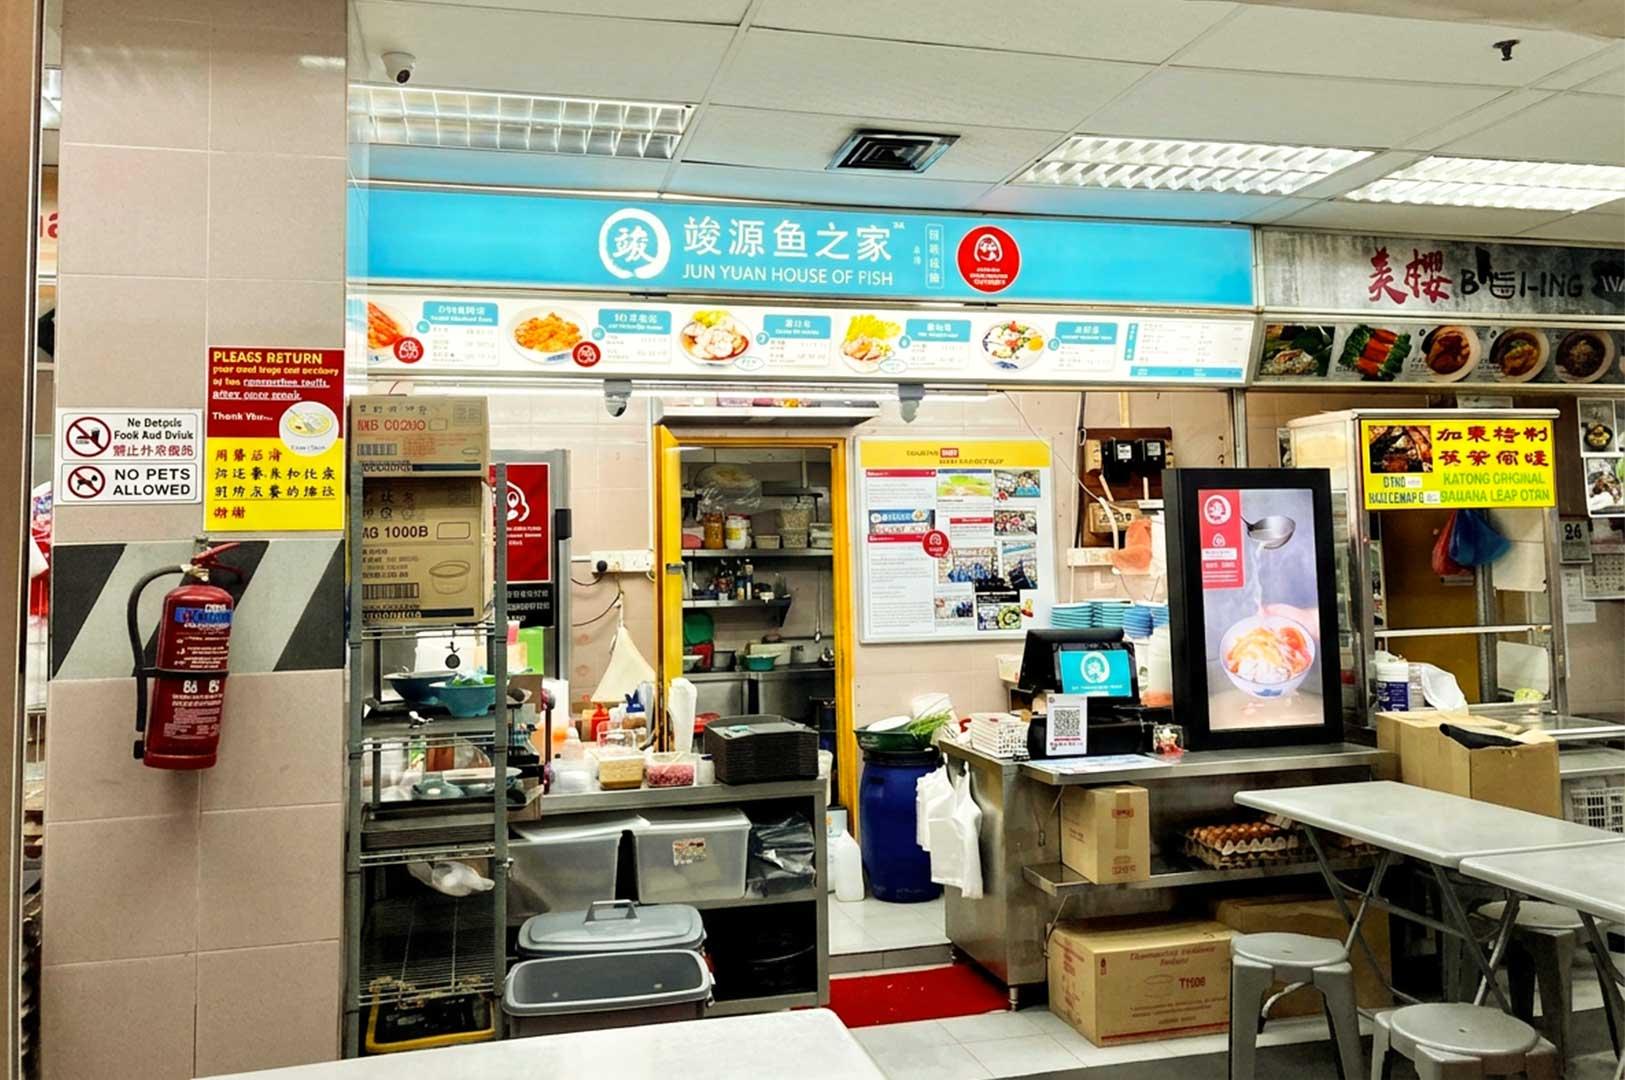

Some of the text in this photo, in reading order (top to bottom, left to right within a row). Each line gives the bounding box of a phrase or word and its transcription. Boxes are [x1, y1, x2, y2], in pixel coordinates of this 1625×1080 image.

[684, 215, 893, 264] 竣源鱼之家
[682, 263, 715, 280] JUN
[719, 265, 767, 283] YUAN
[772, 267, 828, 284] HOUSE
[832, 269, 853, 284] OF
[115, 467, 191, 481] NO PETS
[112, 484, 191, 496] ALLOWED
[384, 525, 429, 538] 1000B
